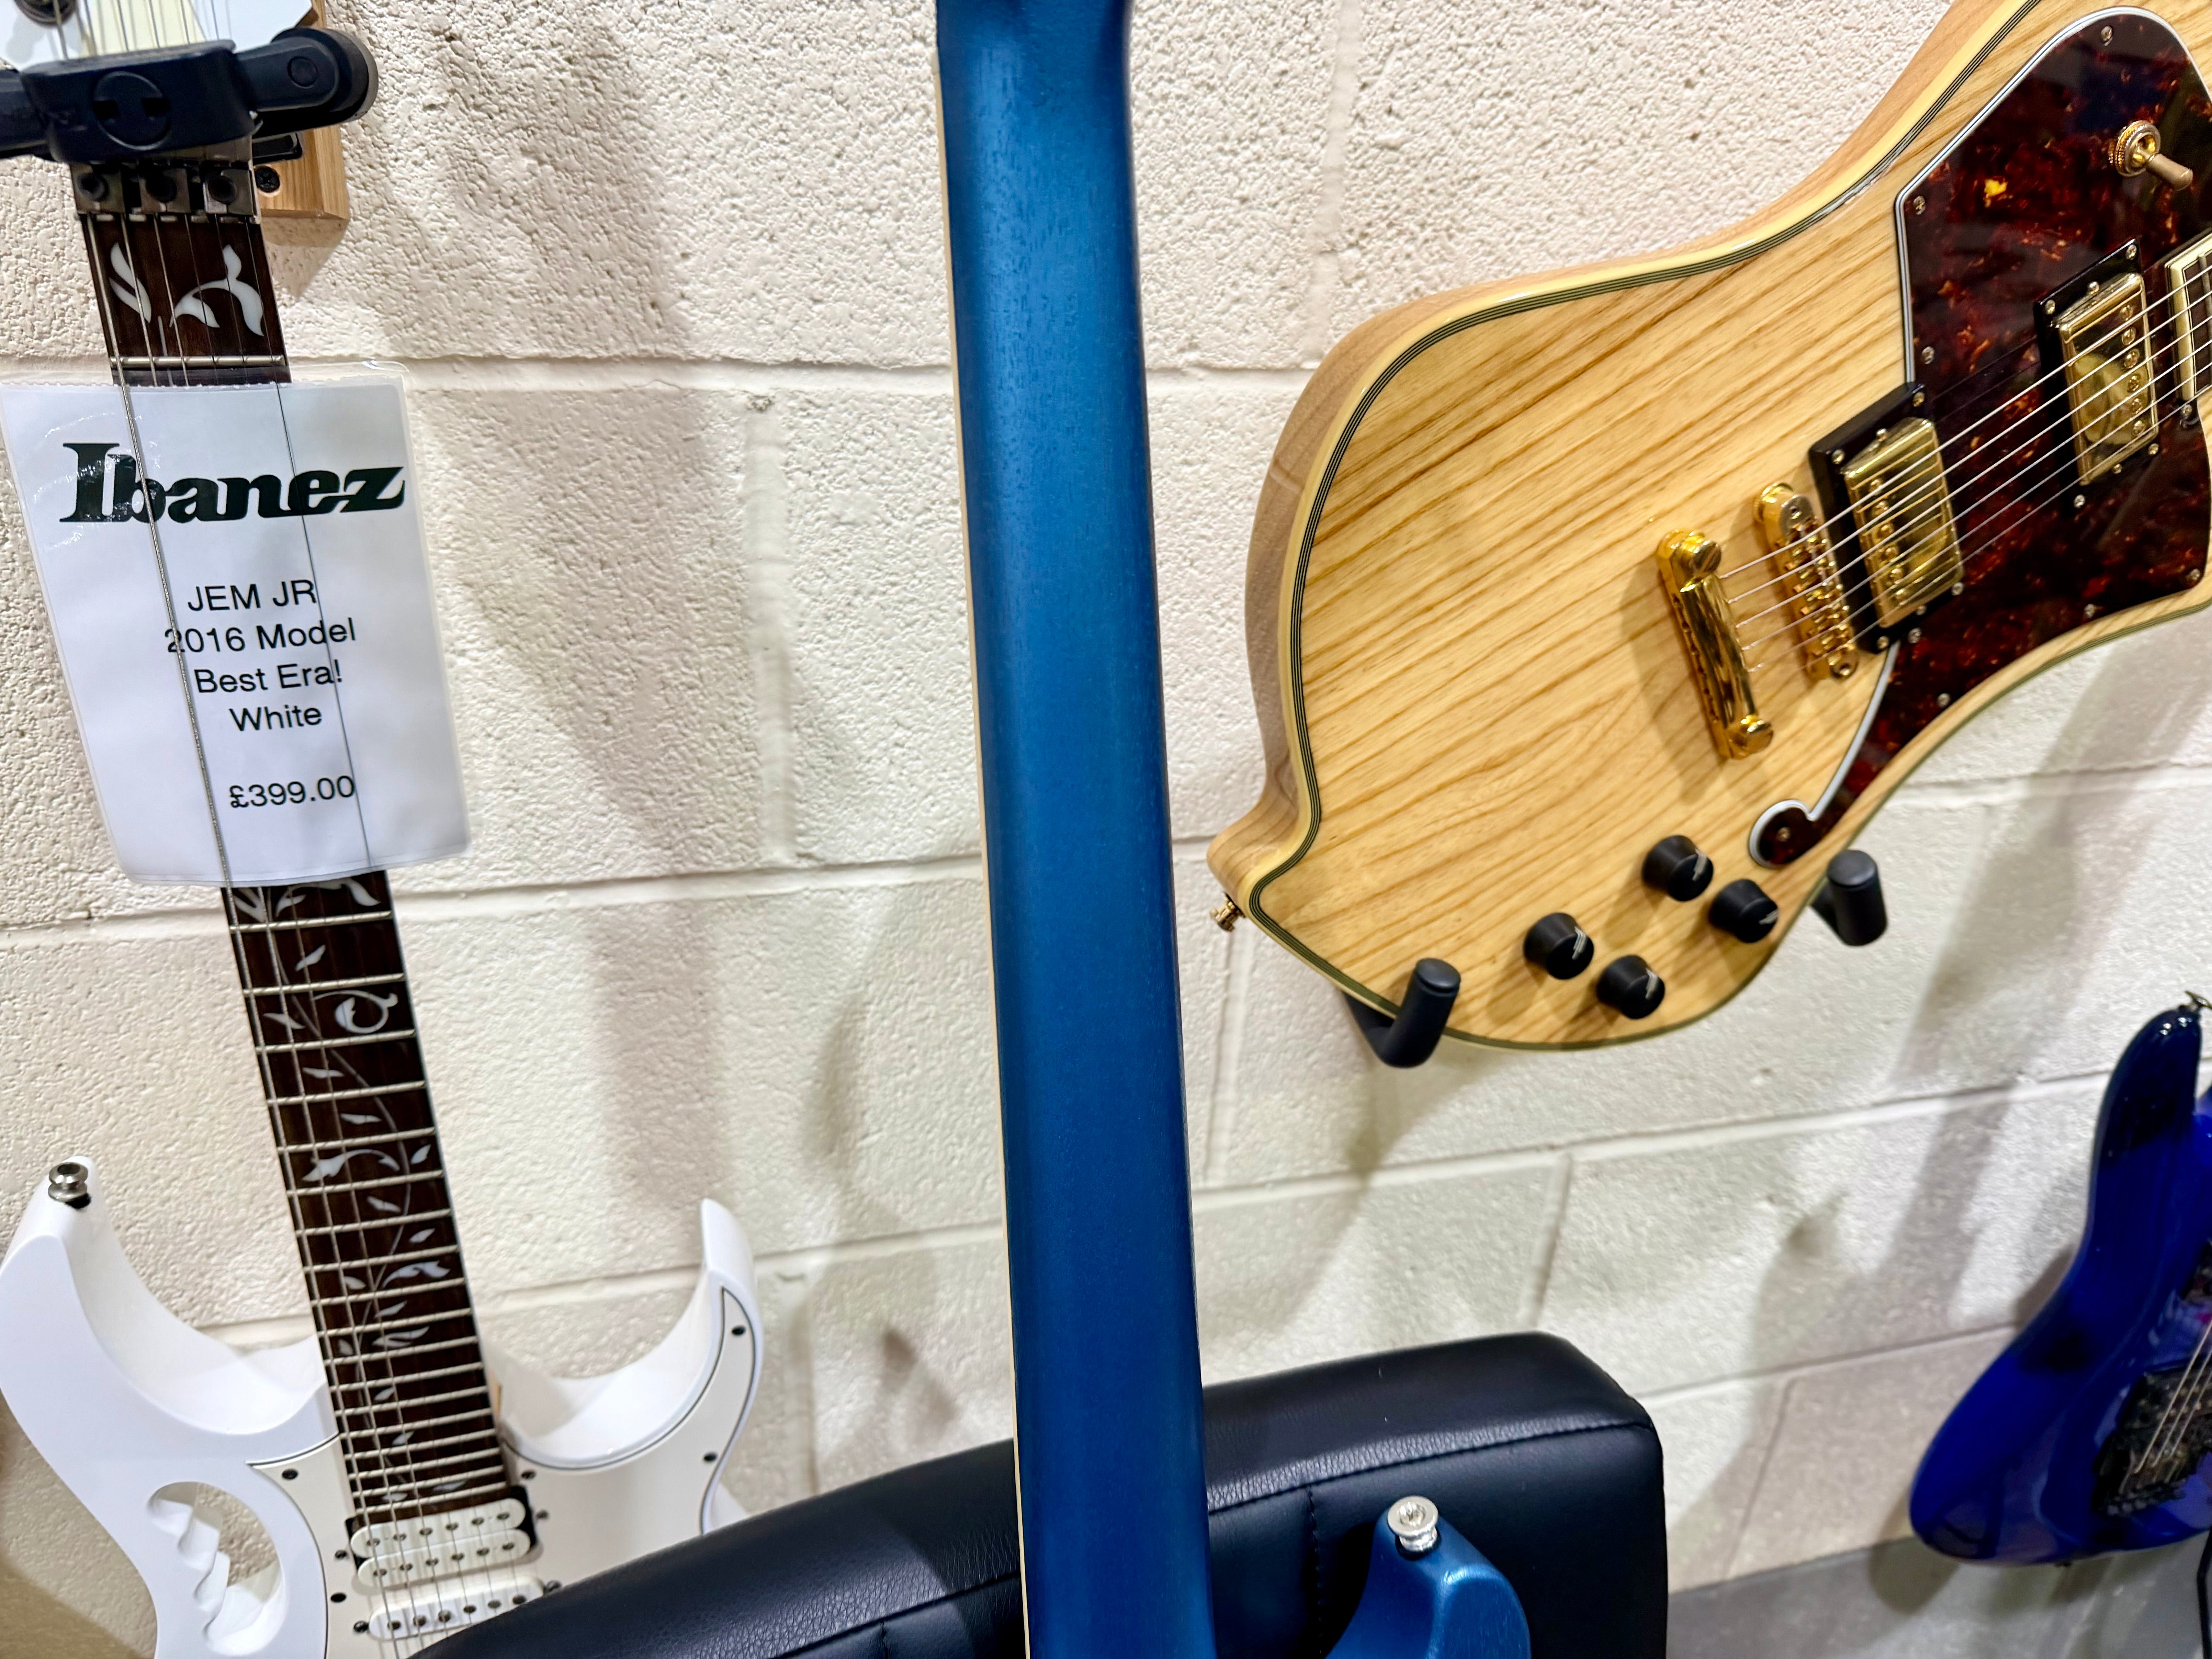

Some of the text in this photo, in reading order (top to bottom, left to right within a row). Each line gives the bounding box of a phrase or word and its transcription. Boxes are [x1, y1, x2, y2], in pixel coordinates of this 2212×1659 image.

[60, 443, 405, 524] Ibanez
[187, 579, 317, 611] JEM JR
[163, 618, 356, 654] 2016 Model
[194, 659, 342, 694] Best Era!
[229, 705, 322, 732] White
[230, 775, 356, 809] £399.00
